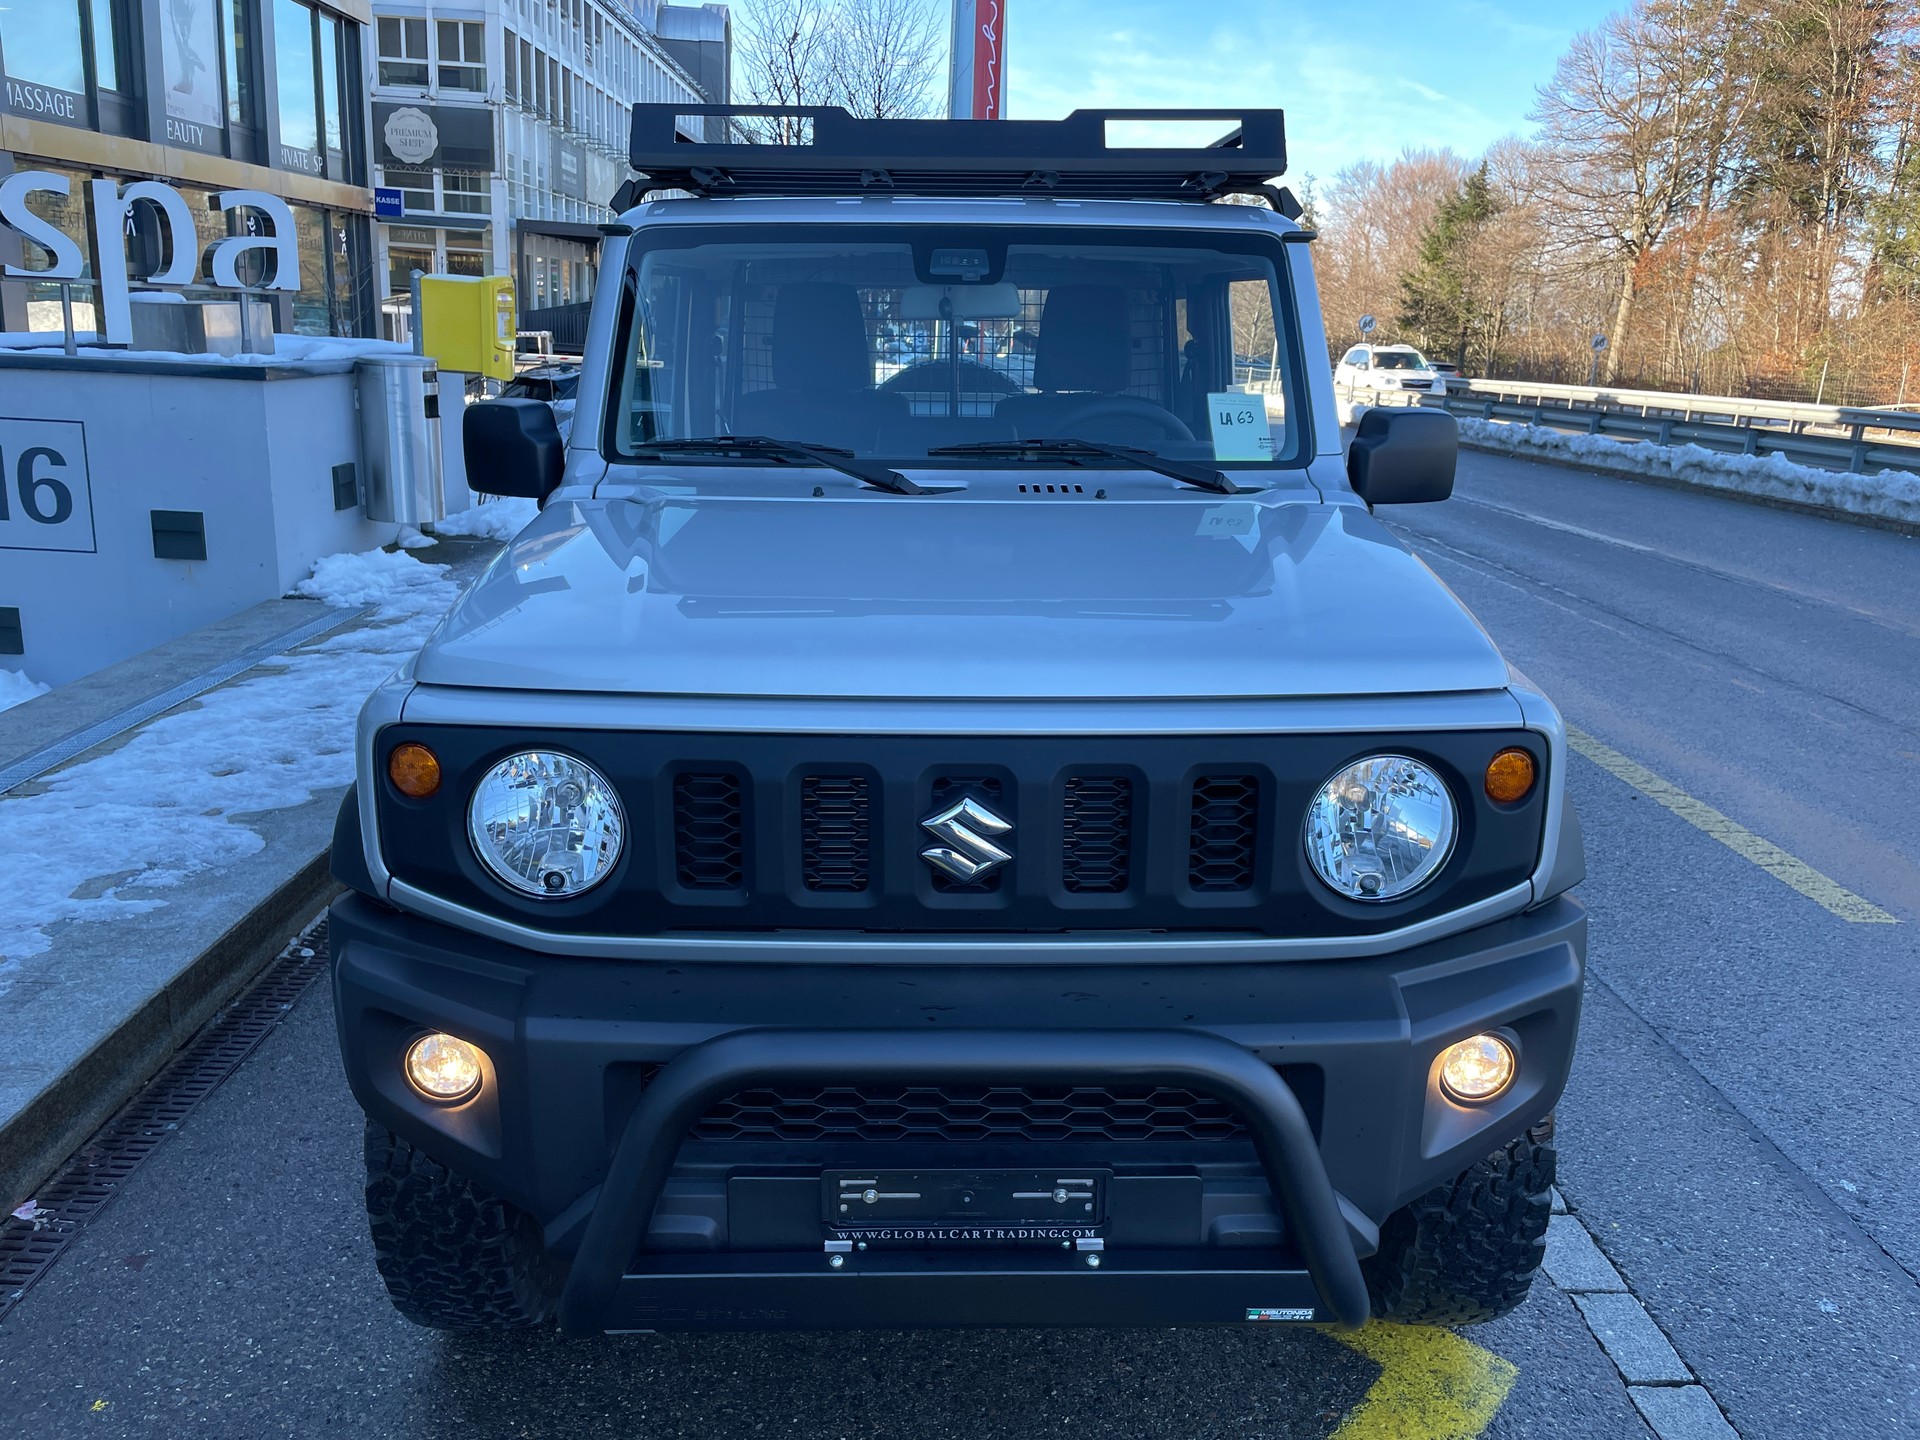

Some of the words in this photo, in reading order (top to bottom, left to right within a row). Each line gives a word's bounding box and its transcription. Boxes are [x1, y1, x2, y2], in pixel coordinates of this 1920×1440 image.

[390, 127, 432, 138] PREMIUM
[375, 196, 400, 205] KASSE
[0, 170, 300, 344] spa
[1220, 412, 1233, 425] LA
[1237, 411, 1254, 424] 63
